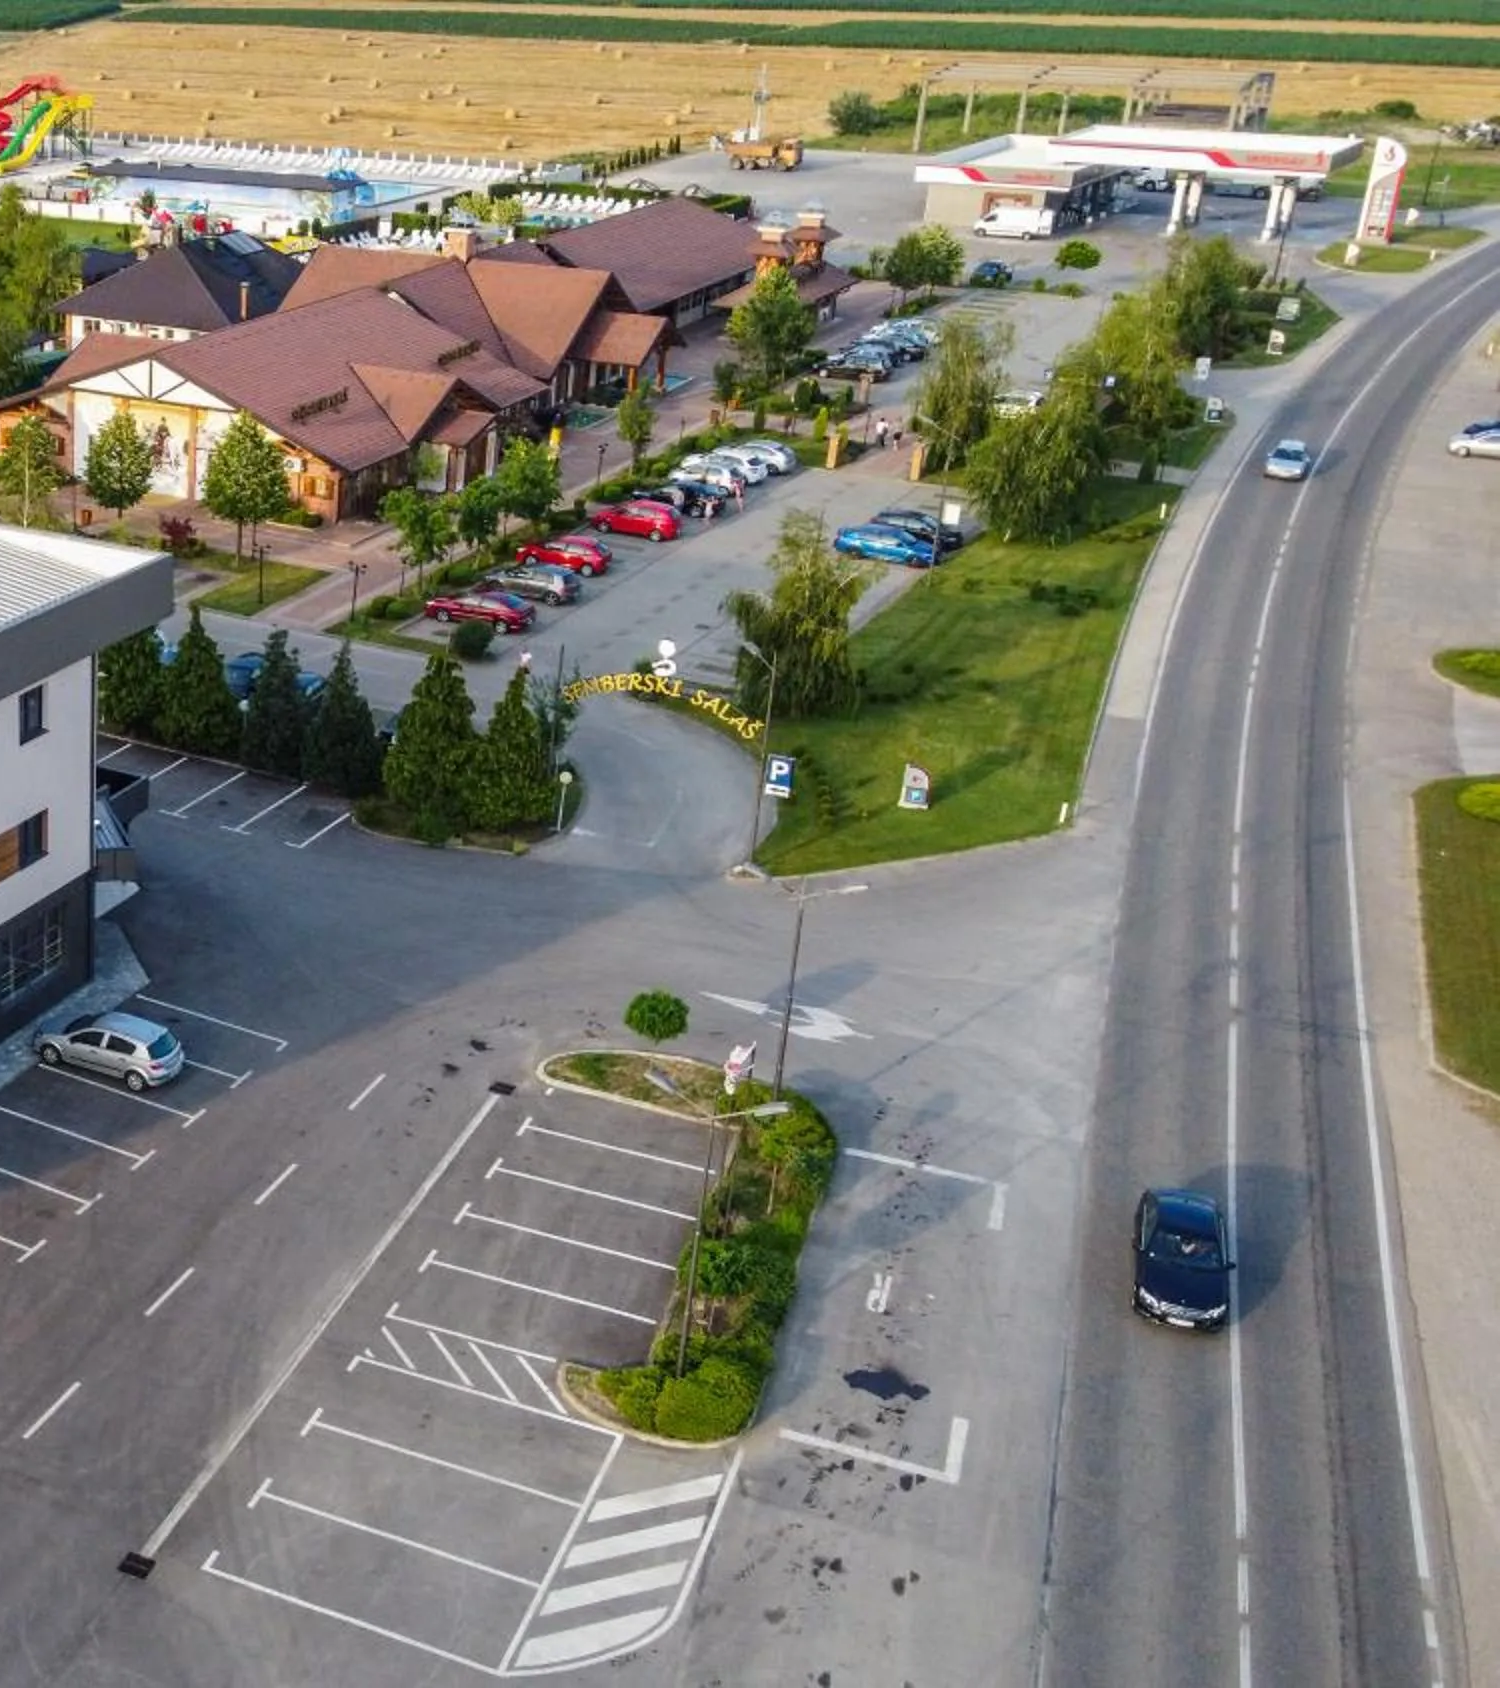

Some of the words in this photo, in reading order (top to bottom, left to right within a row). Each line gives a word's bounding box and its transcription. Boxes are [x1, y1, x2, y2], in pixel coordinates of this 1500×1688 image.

[562, 673, 684, 704] SEMBERSKI
[690, 689, 764, 739] SALAŠ
[771, 760, 789, 781] P
